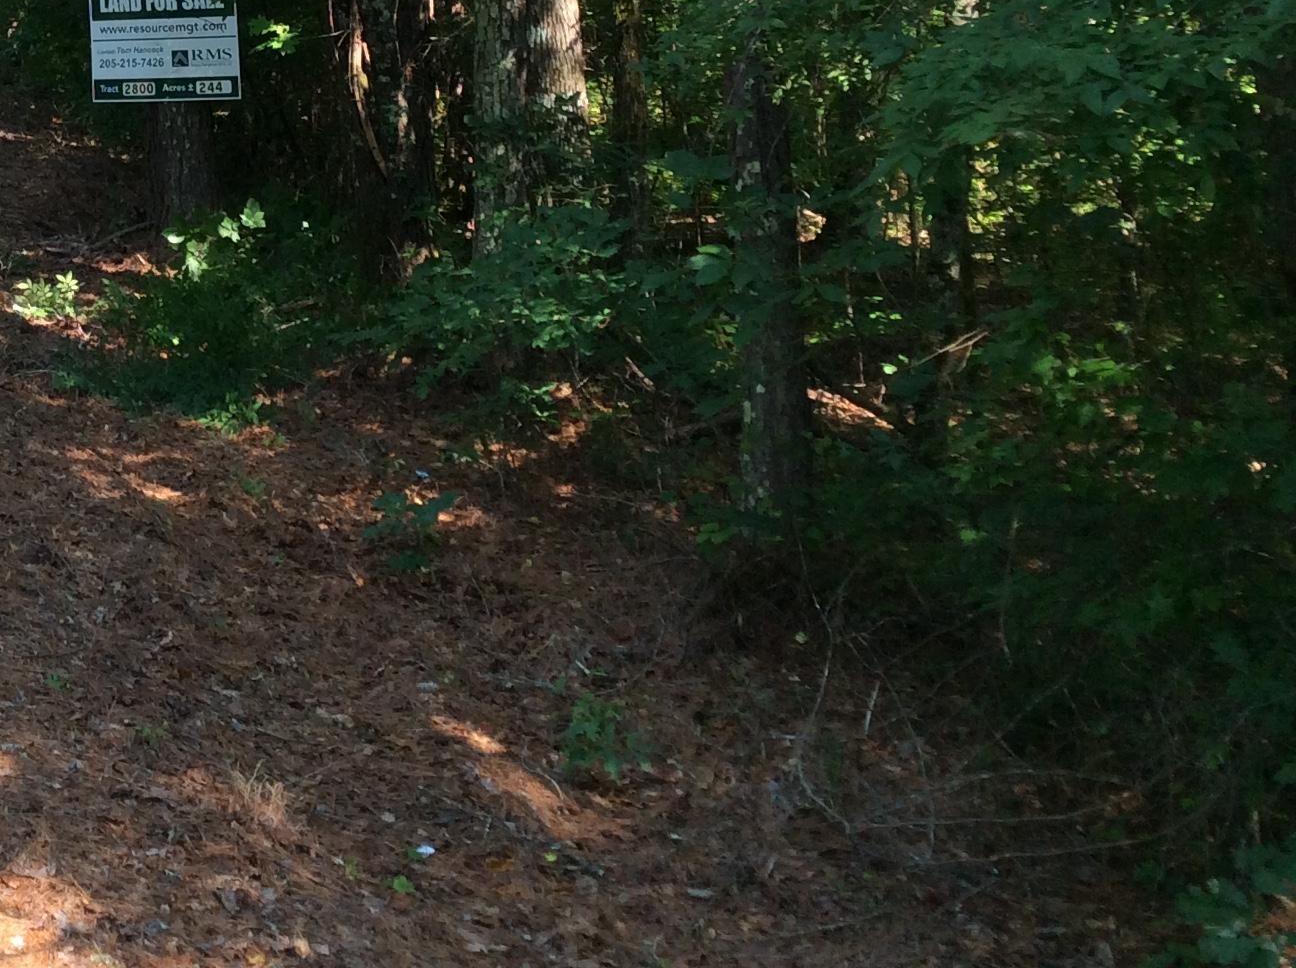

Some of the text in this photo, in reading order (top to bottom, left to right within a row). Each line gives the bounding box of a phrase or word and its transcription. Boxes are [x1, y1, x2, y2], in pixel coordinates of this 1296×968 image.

[99, 22, 227, 35] www.resourcemgt.com
[192, 48, 232, 61] RMS
[99, 57, 164, 69] 205-215-7426
[99, 84, 119, 93] Tract
[124, 83, 154, 95] 2800
[162, 83, 186, 92] Acres
[199, 82, 223, 93] 244
